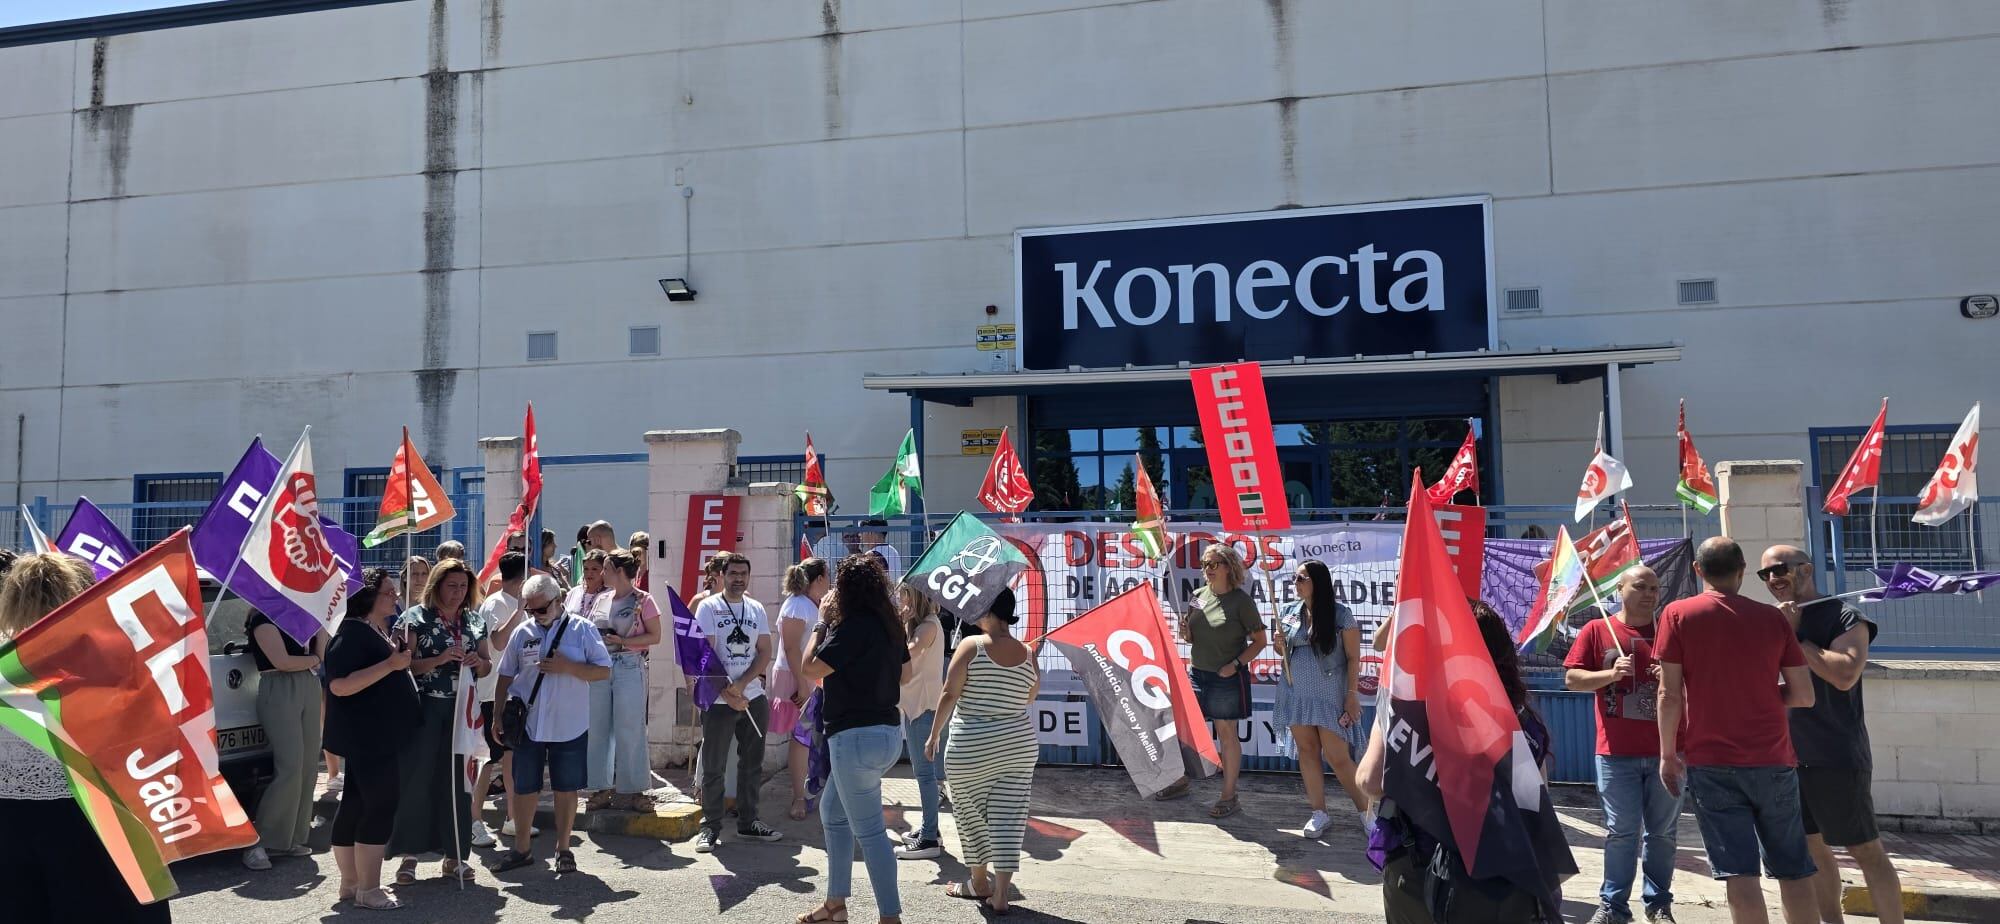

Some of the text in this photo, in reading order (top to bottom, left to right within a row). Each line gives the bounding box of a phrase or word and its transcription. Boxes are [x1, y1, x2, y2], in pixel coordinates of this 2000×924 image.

[1055, 243, 1445, 330] Konecta
[1211, 370, 1260, 488] CCOO
[1243, 518, 1268, 526] Jaén
[1300, 539, 1362, 558] Konecta
[928, 566, 982, 610] CGT
[1066, 575, 1094, 600] DE
[1250, 579, 1295, 604] ALE
[1333, 579, 1394, 606] ADIE
[1039, 710, 1081, 734] DE
[1084, 642, 1158, 762] Andalucía, Ceuta y Melilla
[125, 747, 207, 844] Jaén
